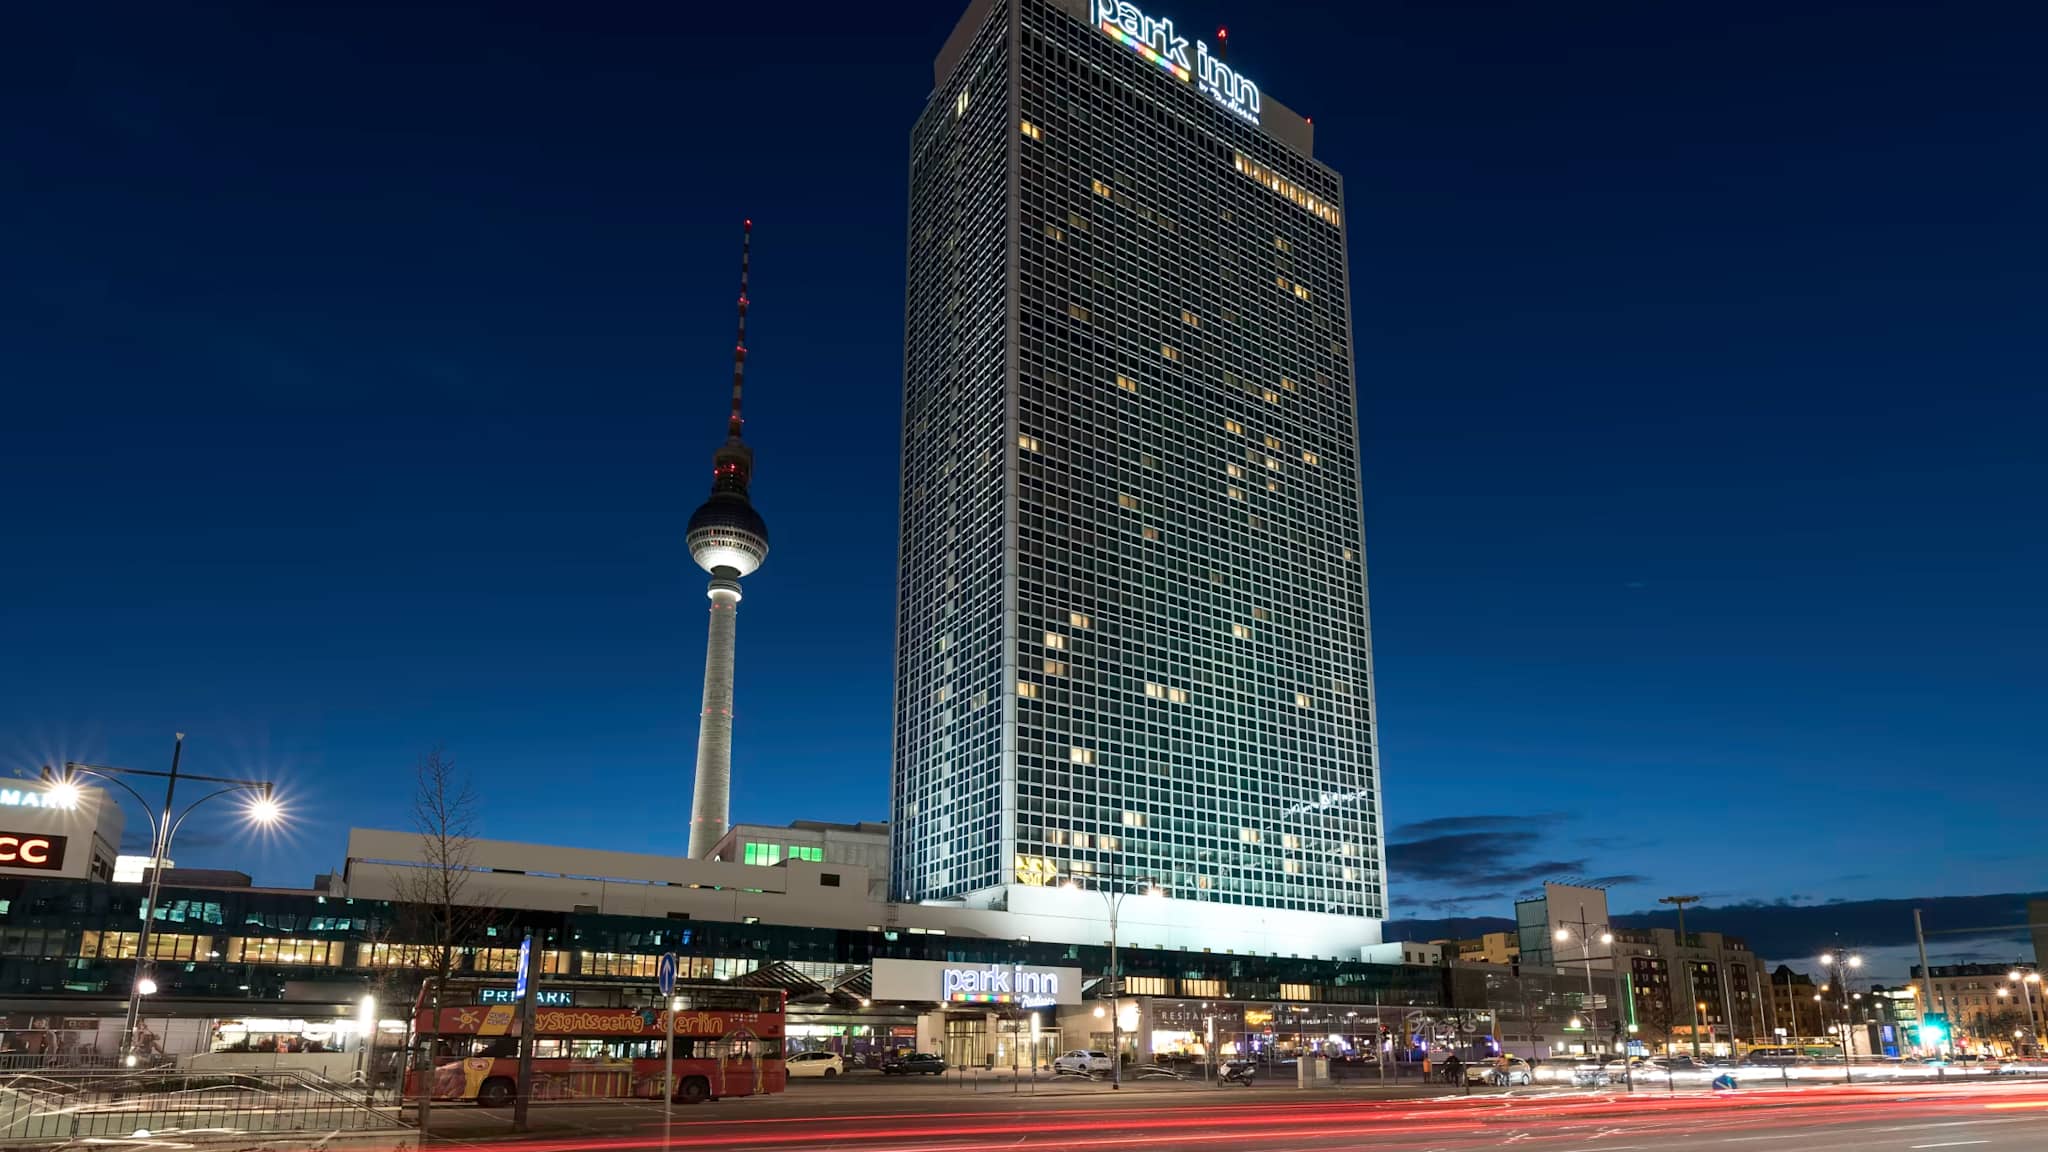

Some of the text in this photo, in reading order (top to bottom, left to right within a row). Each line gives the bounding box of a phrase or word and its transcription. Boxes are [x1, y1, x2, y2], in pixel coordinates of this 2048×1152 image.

[1090, 0, 1260, 114] park inn
[482, 990, 571, 1004] PRIARK
[943, 964, 1059, 1001] park inn
